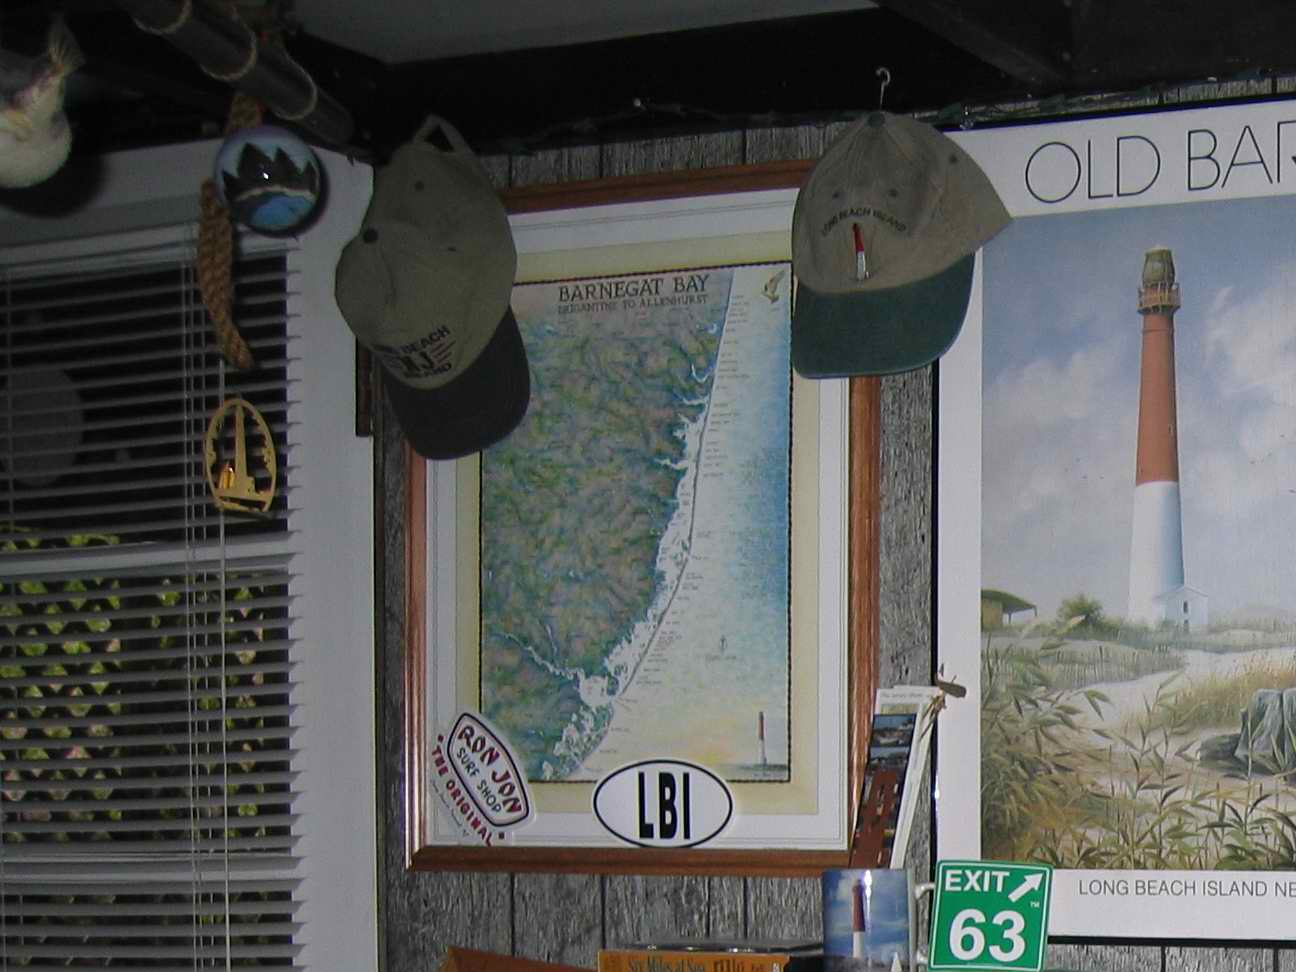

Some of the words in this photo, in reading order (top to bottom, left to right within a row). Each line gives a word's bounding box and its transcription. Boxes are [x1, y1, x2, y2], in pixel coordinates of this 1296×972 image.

[1025, 134, 1161, 204] OLD
[558, 278, 664, 302] BARNEGAT
[673, 273, 711, 294] BAY
[623, 300, 636, 310] TO
[639, 294, 709, 308] ALLENHURST
[400, 325, 451, 355] BEACH
[431, 745, 449, 776] THE
[446, 780, 493, 847] ORIGINAL
[456, 746, 480, 778] SURF
[477, 779, 502, 813] SHOP
[457, 725, 500, 767] RON
[491, 769, 522, 813] JON
[637, 771, 691, 841] LBI
[944, 869, 1010, 893] EXIT
[1078, 879, 1129, 896] LONG
[1134, 880, 1196, 897] BEACH
[1202, 880, 1268, 897] ISLAND
[949, 908, 1026, 963] 63
